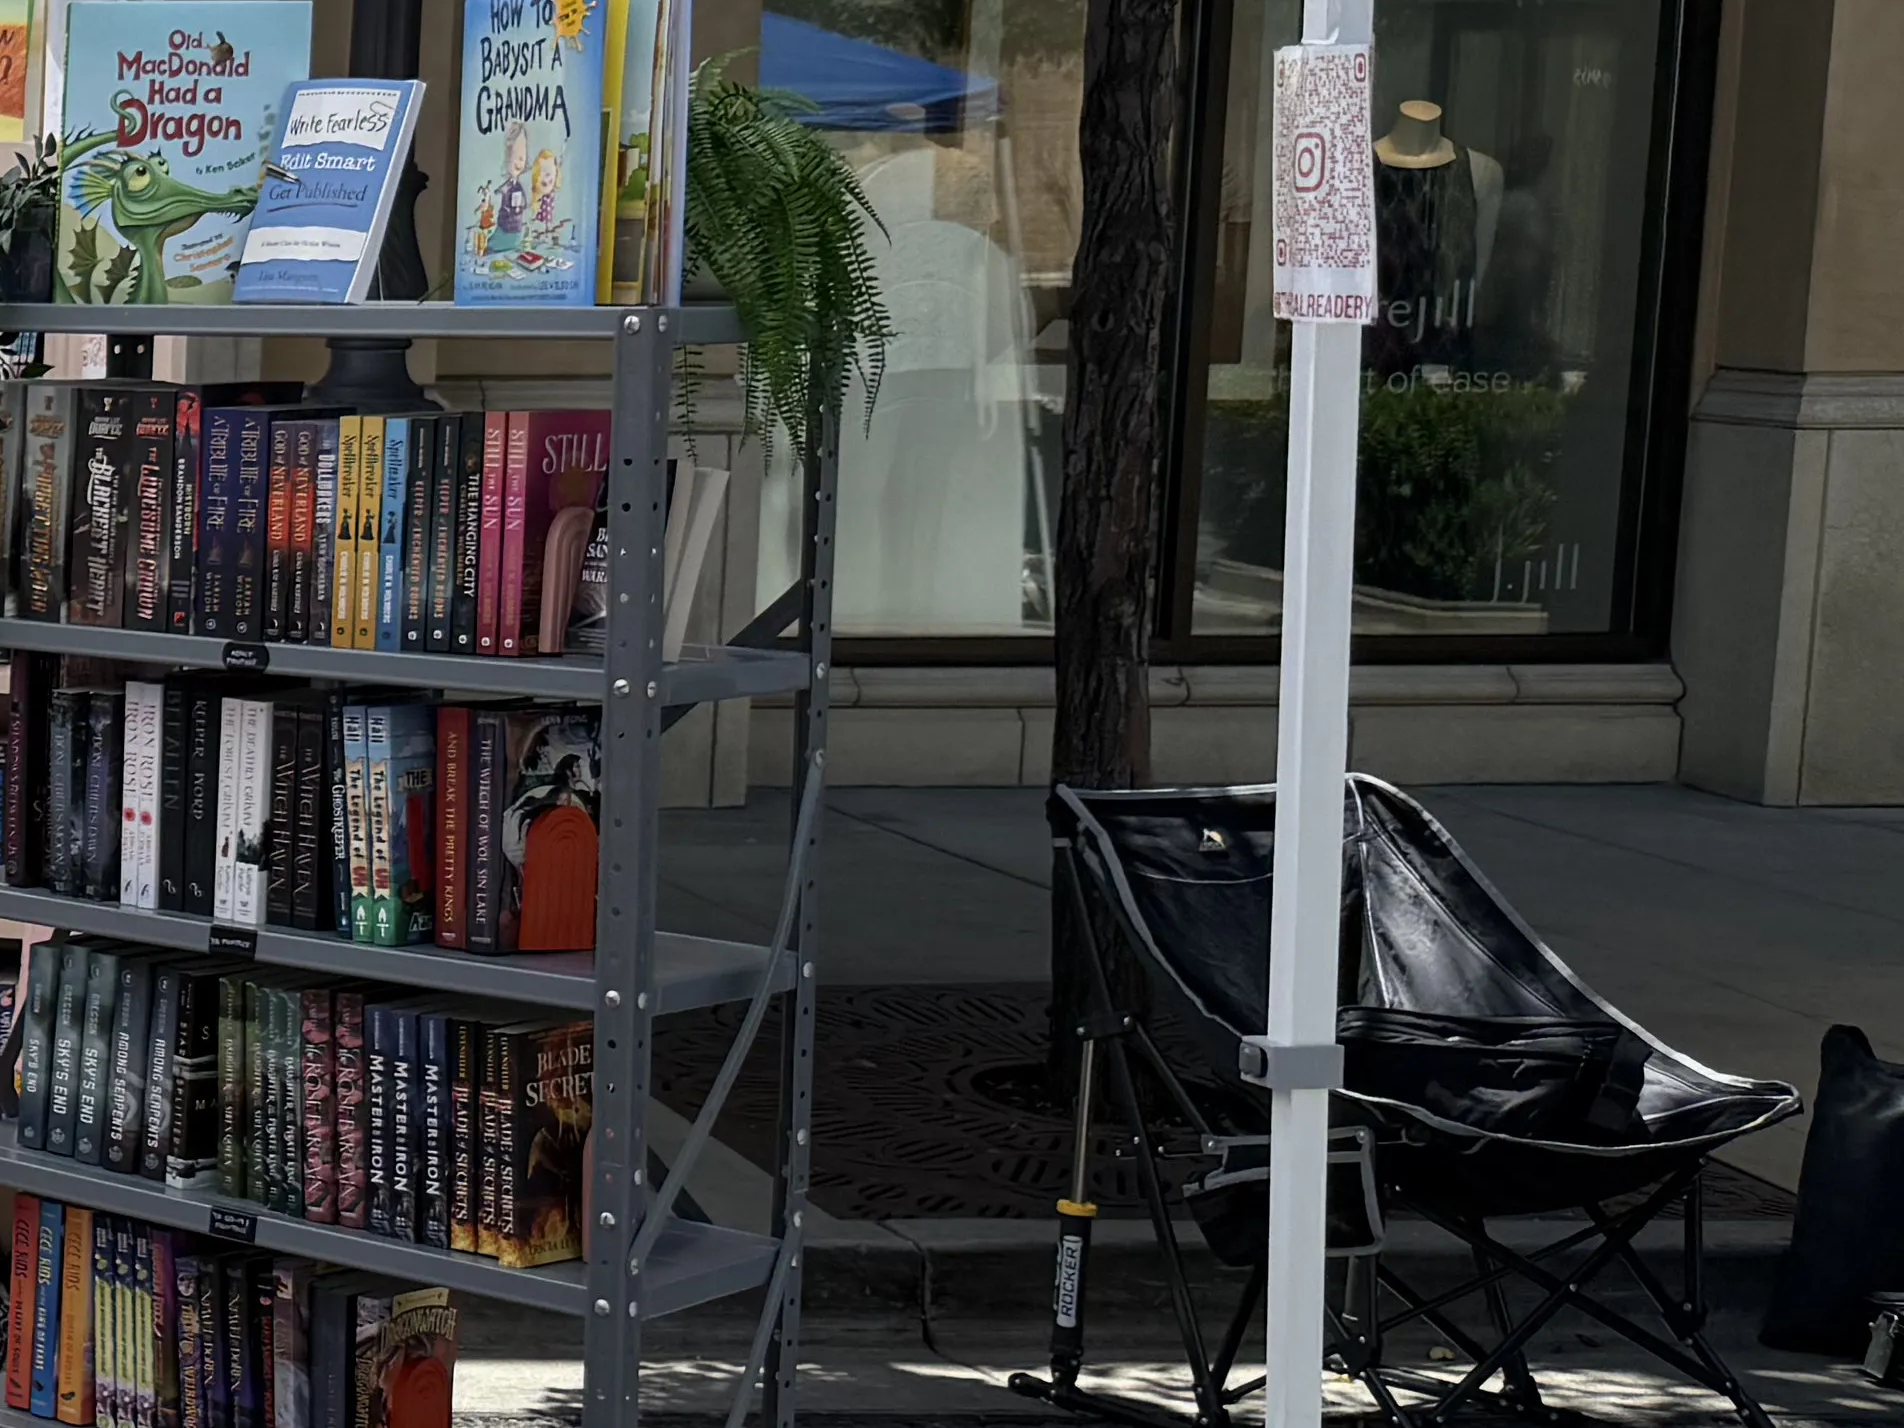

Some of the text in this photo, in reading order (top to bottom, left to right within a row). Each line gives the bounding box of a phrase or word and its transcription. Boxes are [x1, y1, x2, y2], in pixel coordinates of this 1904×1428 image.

[117, 50, 251, 81] MacDonald
[169, 29, 203, 51] Old
[480, 37, 563, 84] BABYSIT A
[148, 79, 222, 105] Had a
[290, 109, 389, 135] Write Fearless
[476, 82, 571, 139] GRANDMA
[116, 98, 242, 157] Dragon
[204, 162, 225, 175] Ken
[269, 182, 368, 203] Get Published
[280, 152, 376, 171] Edit Smart
[1387, 364, 1421, 394] of
[1434, 370, 1511, 394] ease
[176, 458, 185, 504] BRANDON
[270, 430, 287, 540] GOD NEVERLAND
[483, 427, 500, 530] STILL SUN
[506, 429, 524, 531] STILL SUN
[543, 433, 607, 475] STILL
[206, 495, 229, 532] FIRE
[237, 498, 258, 534] FIRE
[295, 431, 311, 541] GOD NEVERLAND
[316, 454, 335, 523] DOLLMAKERS
[463, 473, 480, 597] THE HANGING CITY
[126, 701, 140, 745] IRON
[142, 705, 156, 747] IRON
[190, 700, 207, 820] KEEPER WORD
[243, 733, 257, 781] DEATHLY
[346, 716, 363, 858] Hall The Legend of
[371, 717, 388, 860] Hall The Legend of
[269, 760, 295, 891] WITCH HAVEN
[293, 764, 321, 894] WITCH HAVEN
[331, 784, 346, 860] GHOSTKEEPER
[444, 731, 458, 922] AND BREAK THE PRETTY KINGS
[475, 739, 492, 924] THE WITCH OF WOL SIN LAKE
[53, 1038, 72, 1115] SKY'S END
[80, 1047, 99, 1123] SKY'S END
[111, 1032, 130, 1141] AMONG SERPENTS
[525, 1073, 594, 1108] SECRET
[538, 1044, 591, 1077] BLADE
[146, 1039, 166, 1148] AMONG SERPENTS
[369, 1054, 385, 1184] MASTER IRON
[393, 1061, 410, 1192] MASTER IRON
[424, 1064, 441, 1196] MASTER IRON
[454, 1152, 470, 1220] SECRETS
[498, 1165, 515, 1234] SECRETS
[15, 1219, 29, 1246] CECE
[38, 1226, 53, 1285] CECE RIOS
[66, 1232, 81, 1291] CECE RIOS
